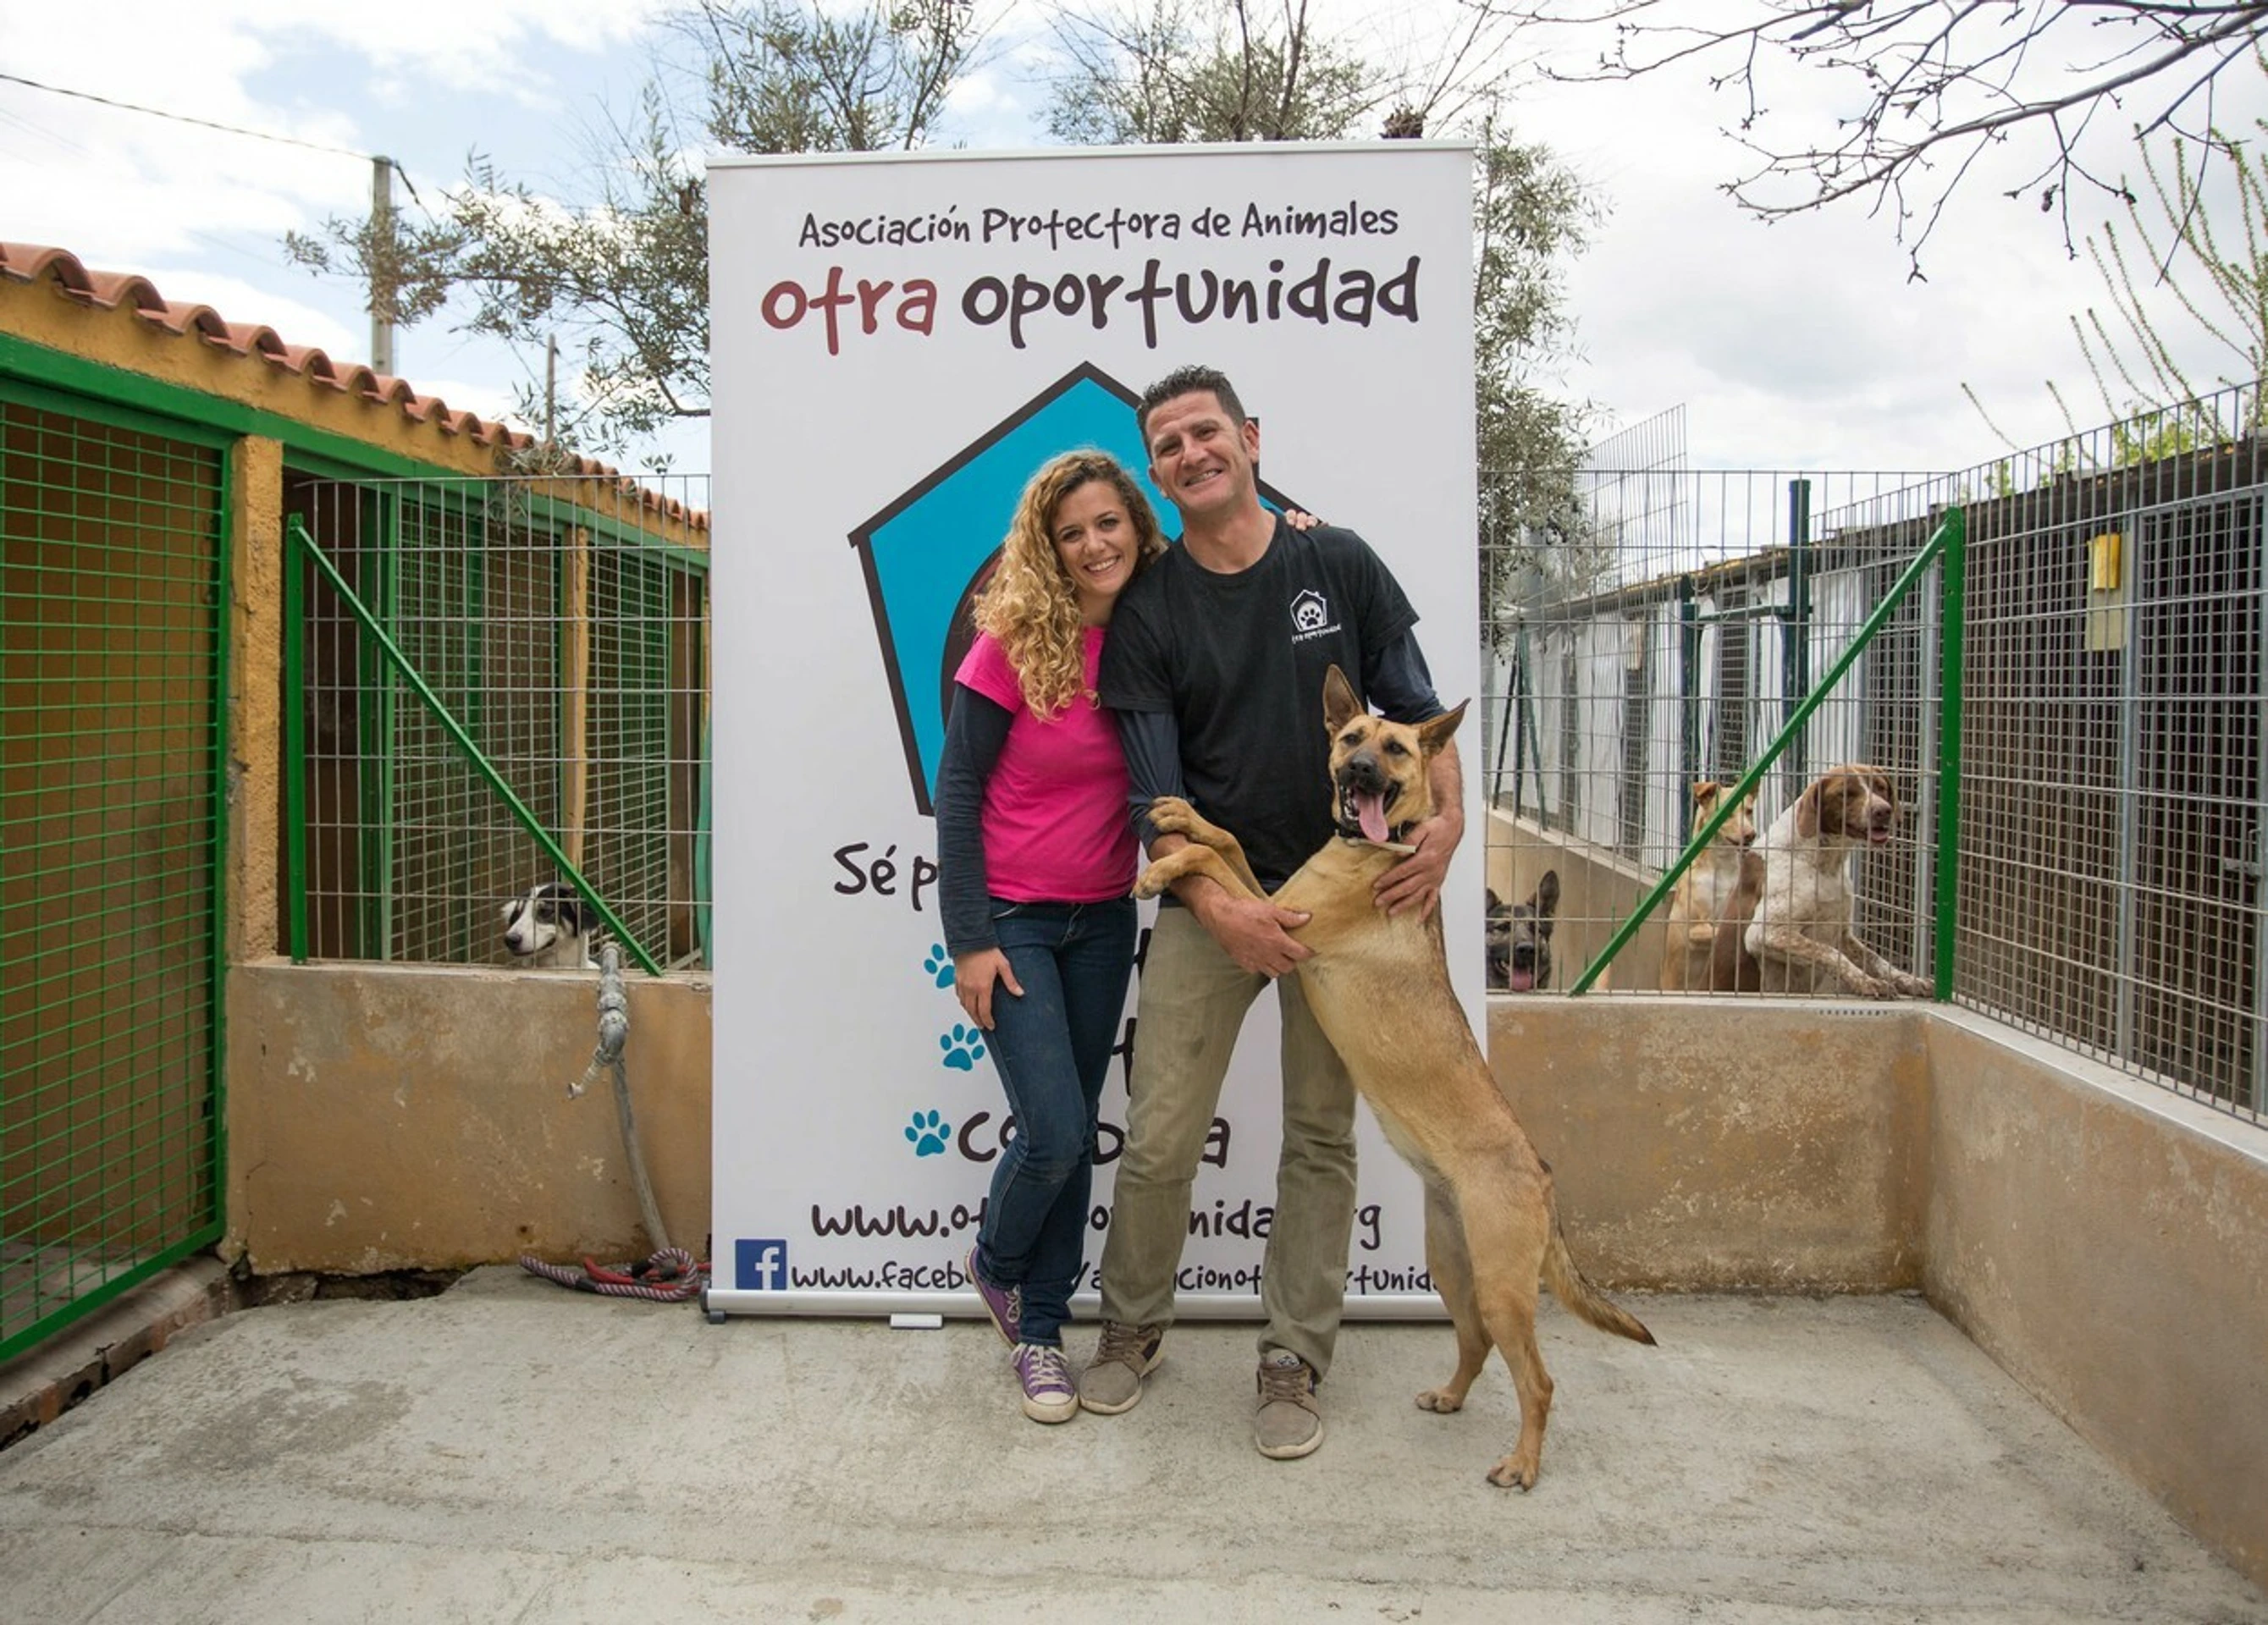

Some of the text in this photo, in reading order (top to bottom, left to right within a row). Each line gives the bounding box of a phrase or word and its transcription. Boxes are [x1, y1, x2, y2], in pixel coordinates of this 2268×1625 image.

[799, 200, 1399, 251] Asociación Protectora de Animales
[760, 255, 1421, 356] otra oportunidad
[833, 842, 897, 895] Sé
